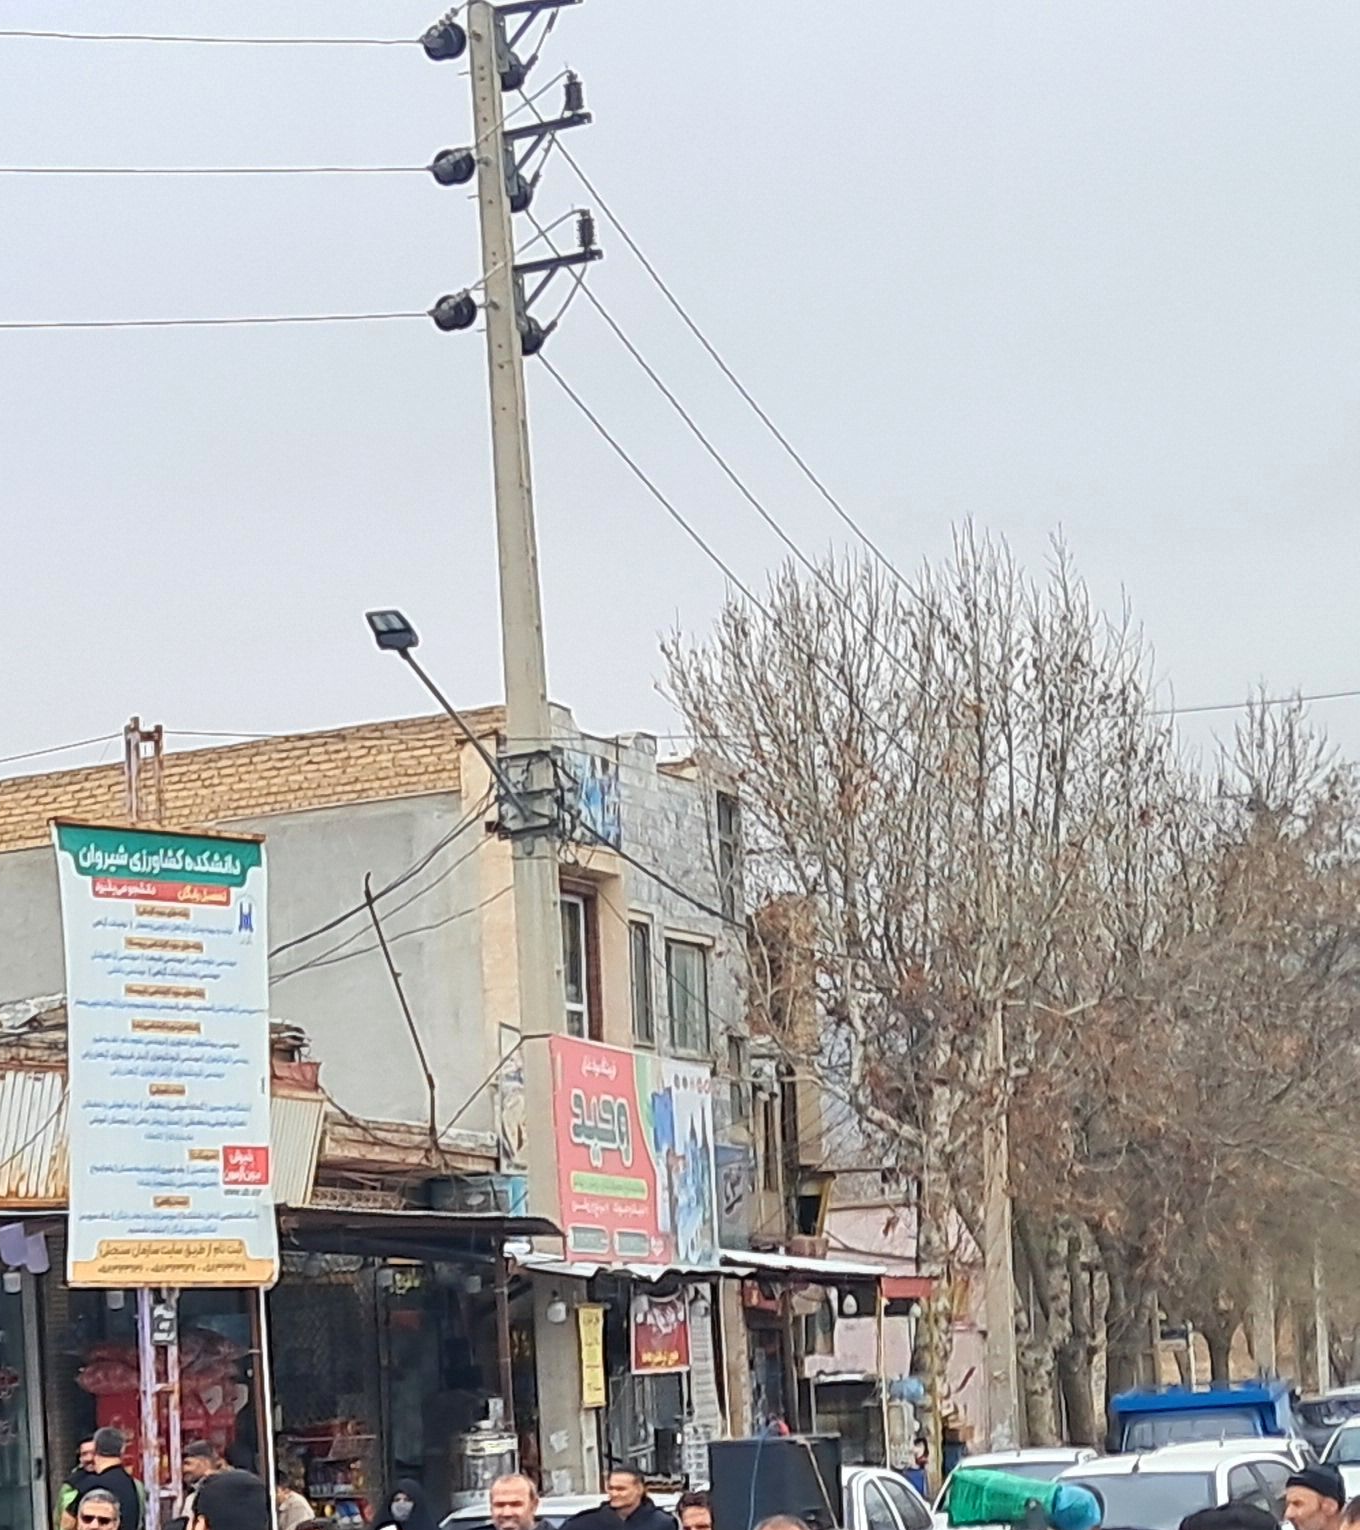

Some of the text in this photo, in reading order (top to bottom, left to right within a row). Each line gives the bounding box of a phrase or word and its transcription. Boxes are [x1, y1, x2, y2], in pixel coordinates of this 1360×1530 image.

[80, 843, 241, 876] دانشکده کشاورزی شیروان
